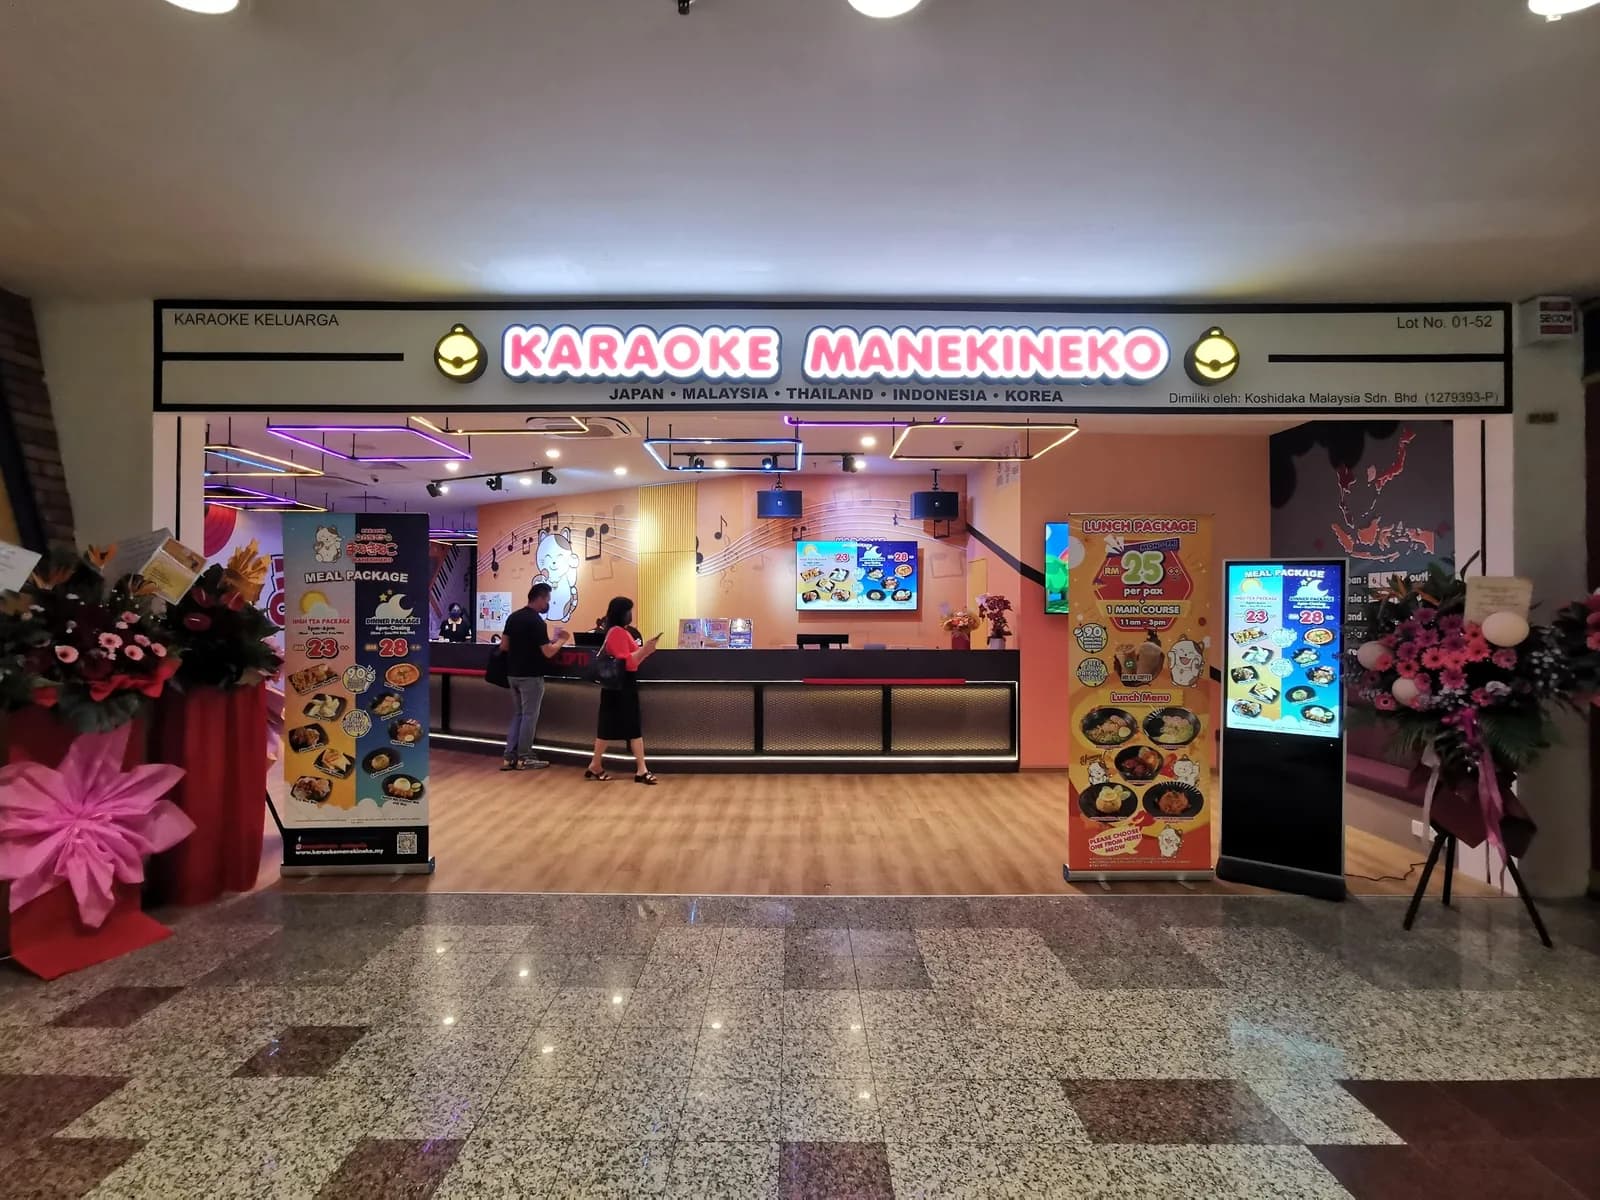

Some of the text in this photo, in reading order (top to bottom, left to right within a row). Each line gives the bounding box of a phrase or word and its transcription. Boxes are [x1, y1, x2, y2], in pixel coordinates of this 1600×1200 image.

[174, 312, 340, 328] KARAOKE KELUARGA
[1397, 315, 1417, 330] Lot
[1451, 314, 1493, 329] 01-52
[506, 329, 1166, 376] KARAOKE MANEKINEKO
[608, 386, 1064, 403] JAPAN MALAYSIA THAILAND INDONESIA KOREA
[1168, 392, 1210, 404] Dimiliki
[1212, 392, 1241, 404] oleh:
[1244, 392, 1306, 404] Koshidaka
[1309, 391, 1361, 405] Malaysia
[1424, 391, 1499, 405] (1279393-P)
[1083, 519, 1198, 534] LUNCH PACKAGE
[835, 553, 850, 562] 23
[894, 552, 908, 562] 28
[1104, 551, 1165, 586] RM 25
[1244, 568, 1326, 579] MEAL PACKAGE
[304, 570, 409, 584] MEAL PACKAGE
[1123, 587, 1164, 597] per pax
[1107, 604, 1181, 615] 1 MAIN COURSE
[1245, 610, 1268, 623] 23
[1300, 610, 1325, 623] 28
[1119, 618, 1141, 627] 11am
[1148, 618, 1167, 628] 3pm
[1084, 625, 1102, 637] 90
[306, 637, 338, 659] 23
[379, 637, 409, 658] 28
[1111, 691, 1171, 704] Lunch Menu
[1089, 828, 1139, 845] PLEASE CHOOSE
[1090, 842, 1105, 852] ONE
[1104, 838, 1124, 848] FROM
